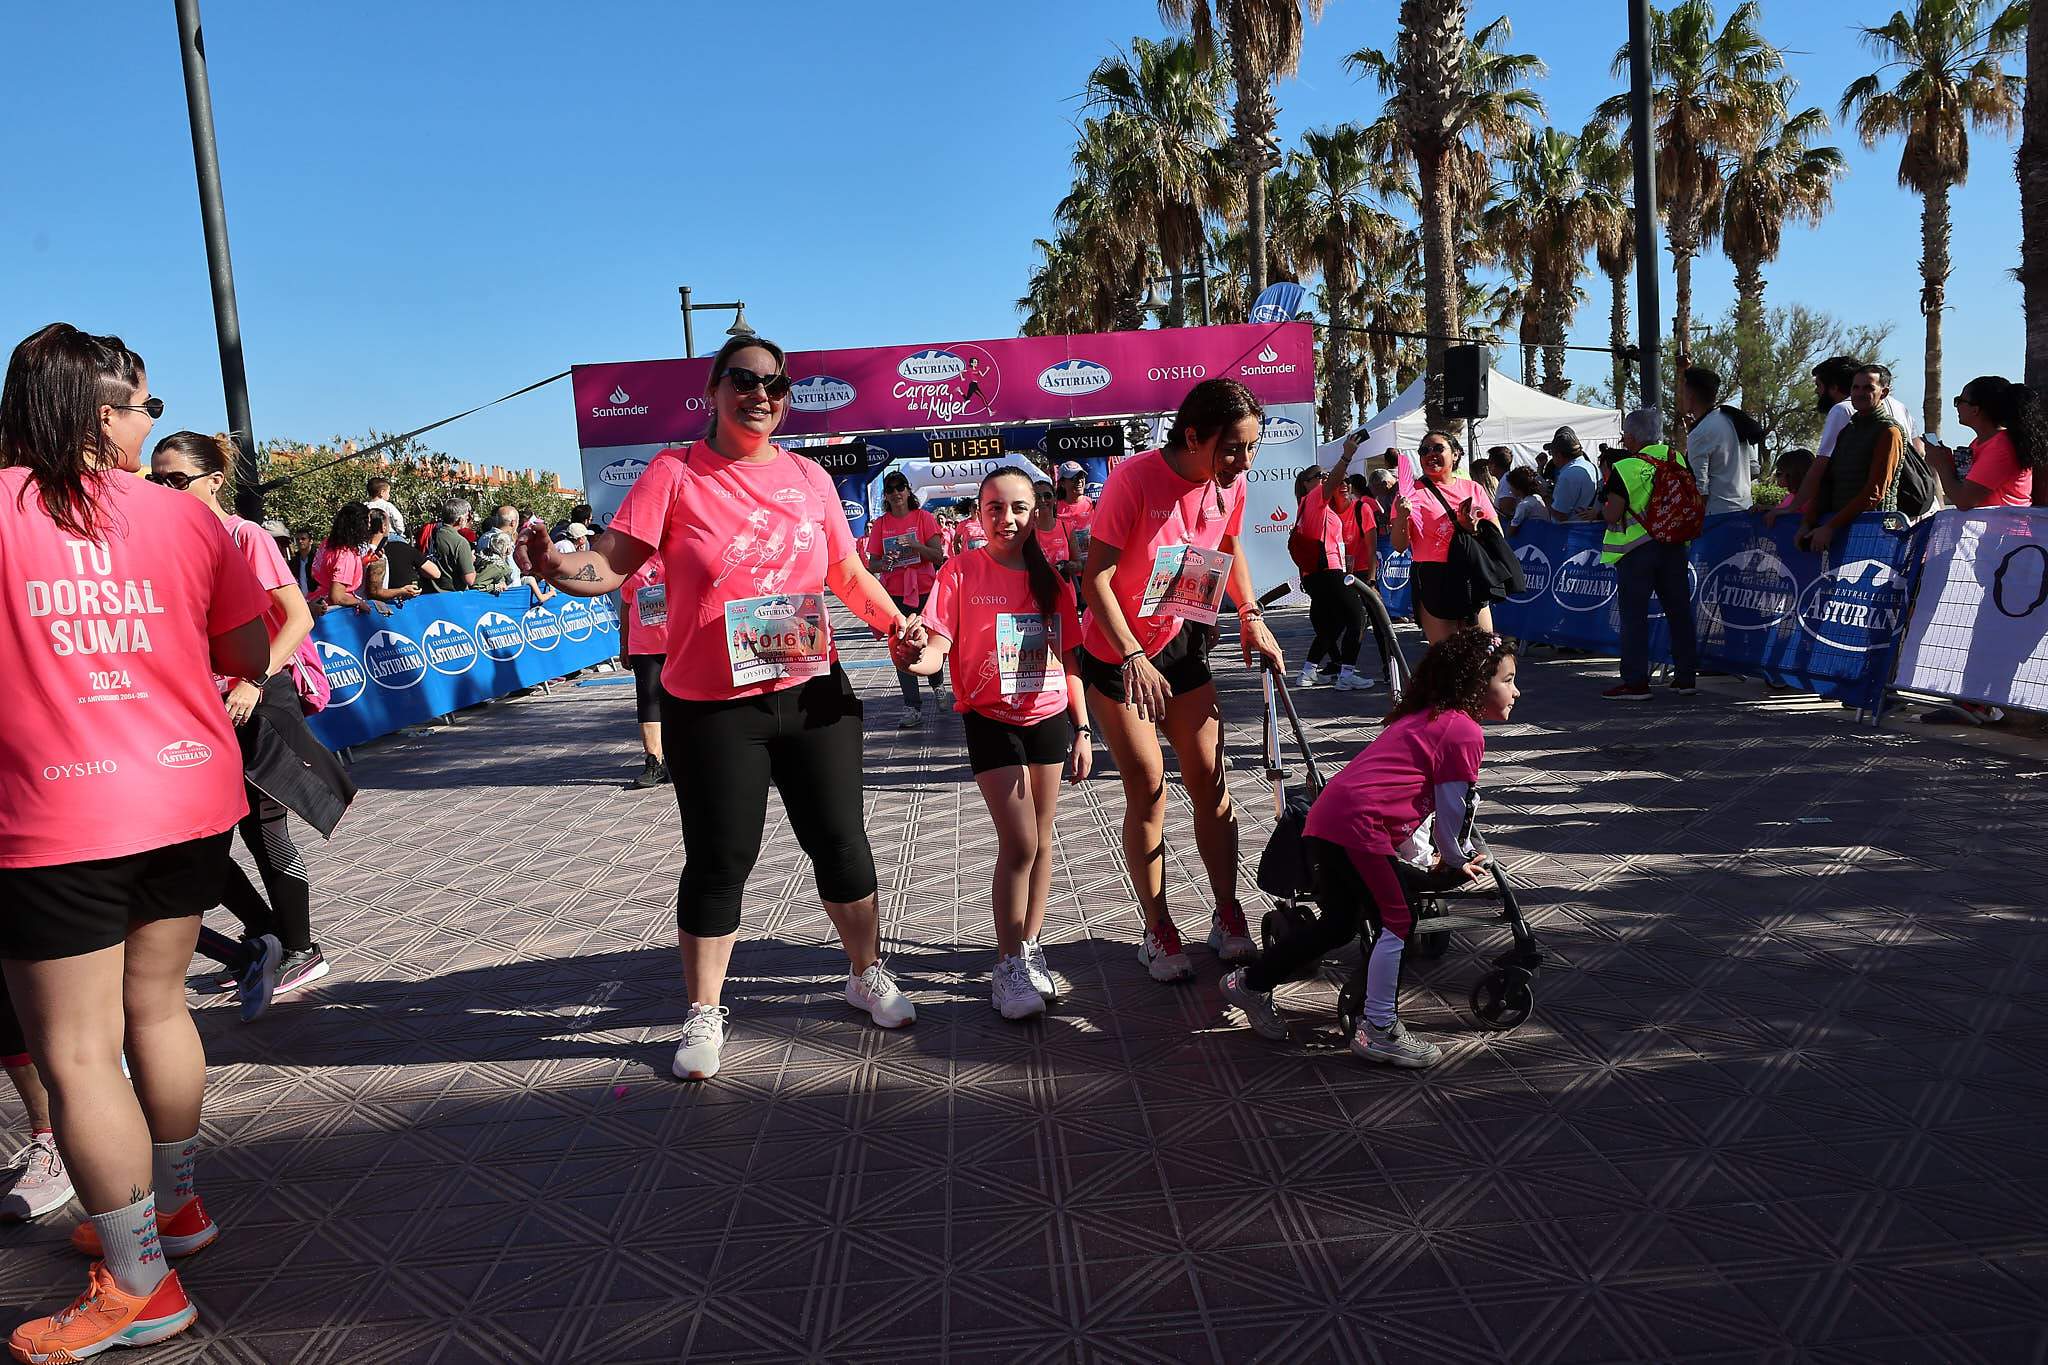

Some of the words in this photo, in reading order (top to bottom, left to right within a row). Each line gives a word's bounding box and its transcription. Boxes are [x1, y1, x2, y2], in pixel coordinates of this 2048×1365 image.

[903, 363, 960, 375] ASTURIANA
[1148, 364, 1206, 381] OYSHO
[1241, 363, 1296, 375] Santander
[893, 382, 949, 398] Carrera
[1044, 375, 1106, 387] ASTURIANA
[790, 391, 850, 404] ASTURIANA
[592, 405, 648, 418] Santander
[907, 399, 919, 411] de
[921, 399, 928, 410] la
[927, 393, 971, 422] Mujer
[930, 428, 993, 440] ASTURIANA
[1058, 435, 1114, 450] OYSHO
[813, 453, 857, 467] YSHO
[931, 461, 999, 479] OYSHO
[65, 540, 112, 577] TU
[1555, 569, 1611, 597] ASTURIANA
[26, 579, 164, 617] DORSAL
[971, 596, 1007, 605] OYSHO
[1703, 575, 1786, 614] ATURIANA
[1803, 587, 1901, 631] ASTURIAN
[50, 619, 152, 656] SUMA
[526, 623, 560, 642] ASTURIANA
[760, 632, 797, 648] 016
[480, 632, 523, 652] ASTURIANA
[428, 641, 475, 665] ASTURIANA
[370, 653, 424, 679] ASTURIANA
[89, 670, 132, 691] 2024
[163, 751, 209, 764] ASTURIANA
[43, 759, 117, 780] OYSHO
